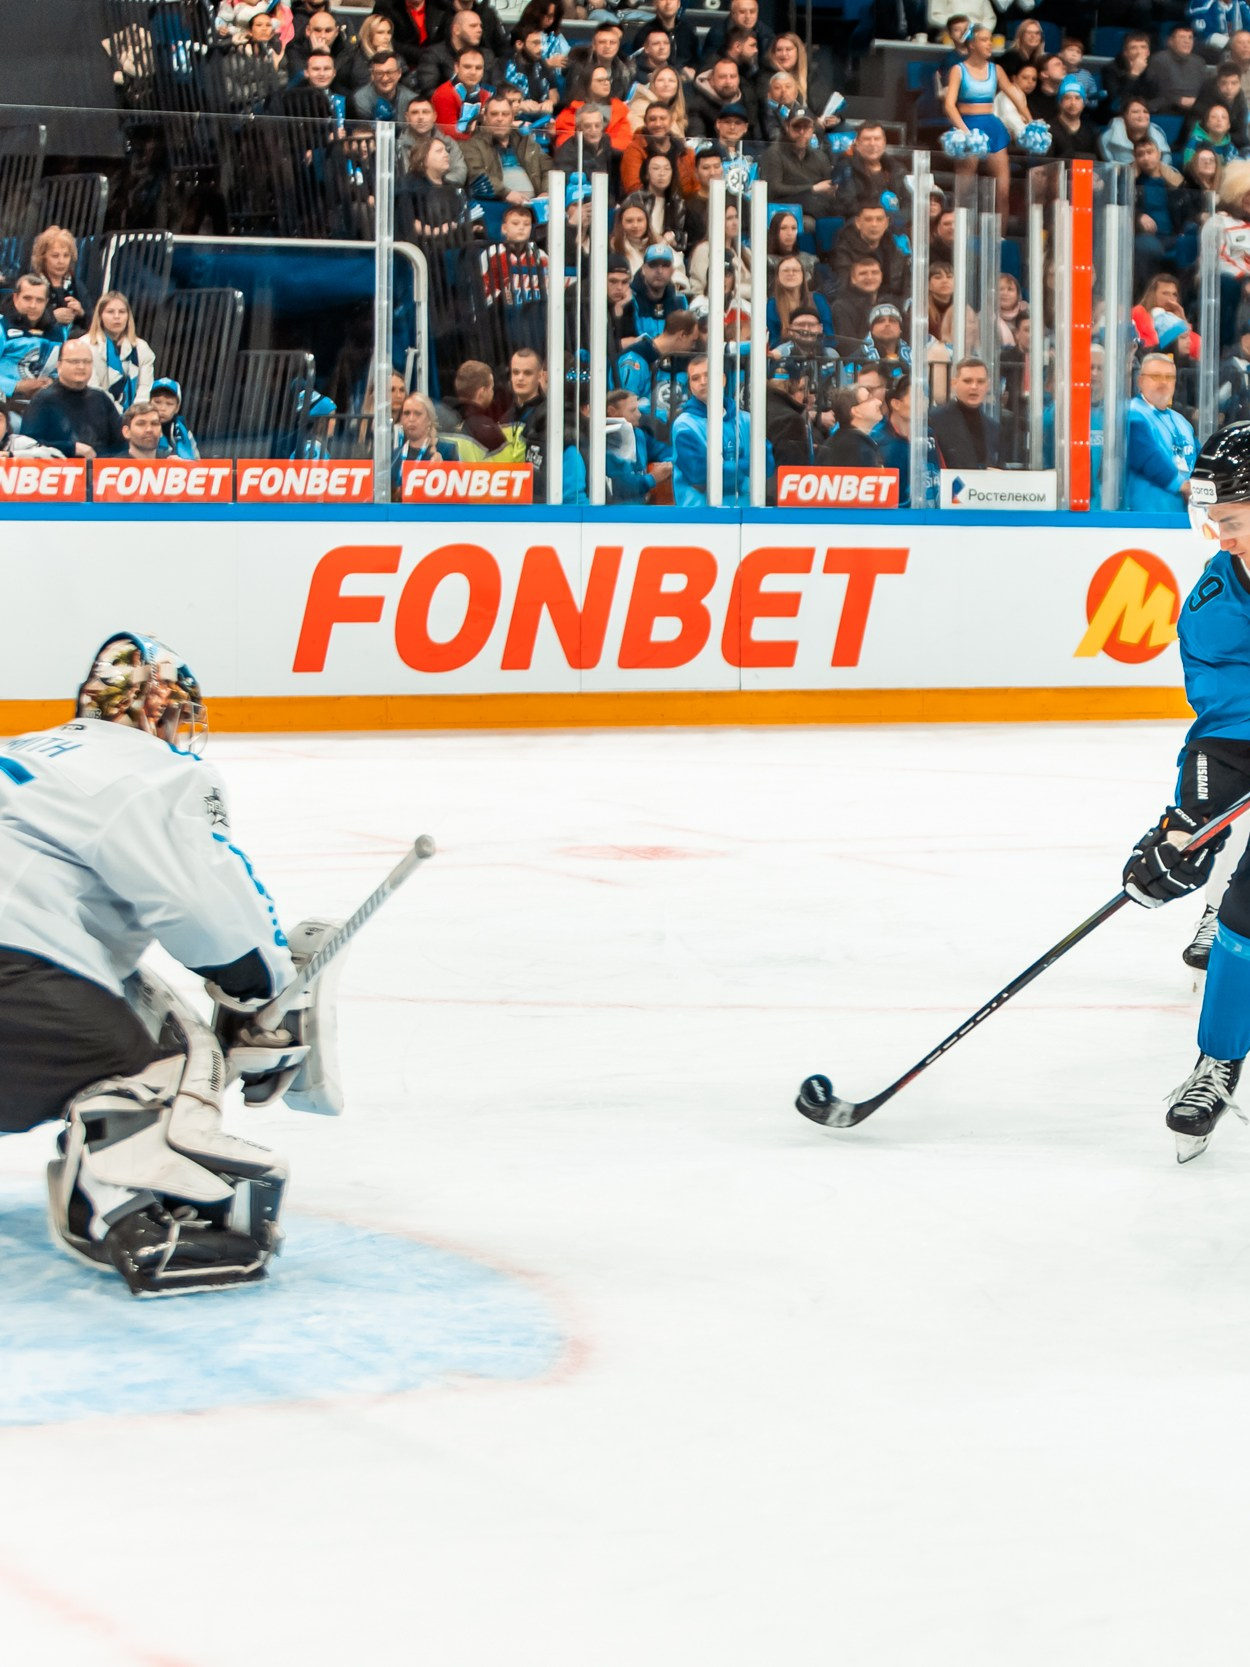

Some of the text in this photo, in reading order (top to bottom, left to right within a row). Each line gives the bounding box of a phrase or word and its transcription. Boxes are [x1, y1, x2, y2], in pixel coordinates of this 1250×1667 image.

[96, 466, 231, 496] FONBET
[240, 467, 371, 496] FONBET
[404, 469, 531, 497] FONBET
[780, 473, 897, 503] FONBET
[967, 487, 1046, 502] Ростелеком
[292, 543, 910, 674] FONBET
[1175, 808, 1197, 827] CCM
